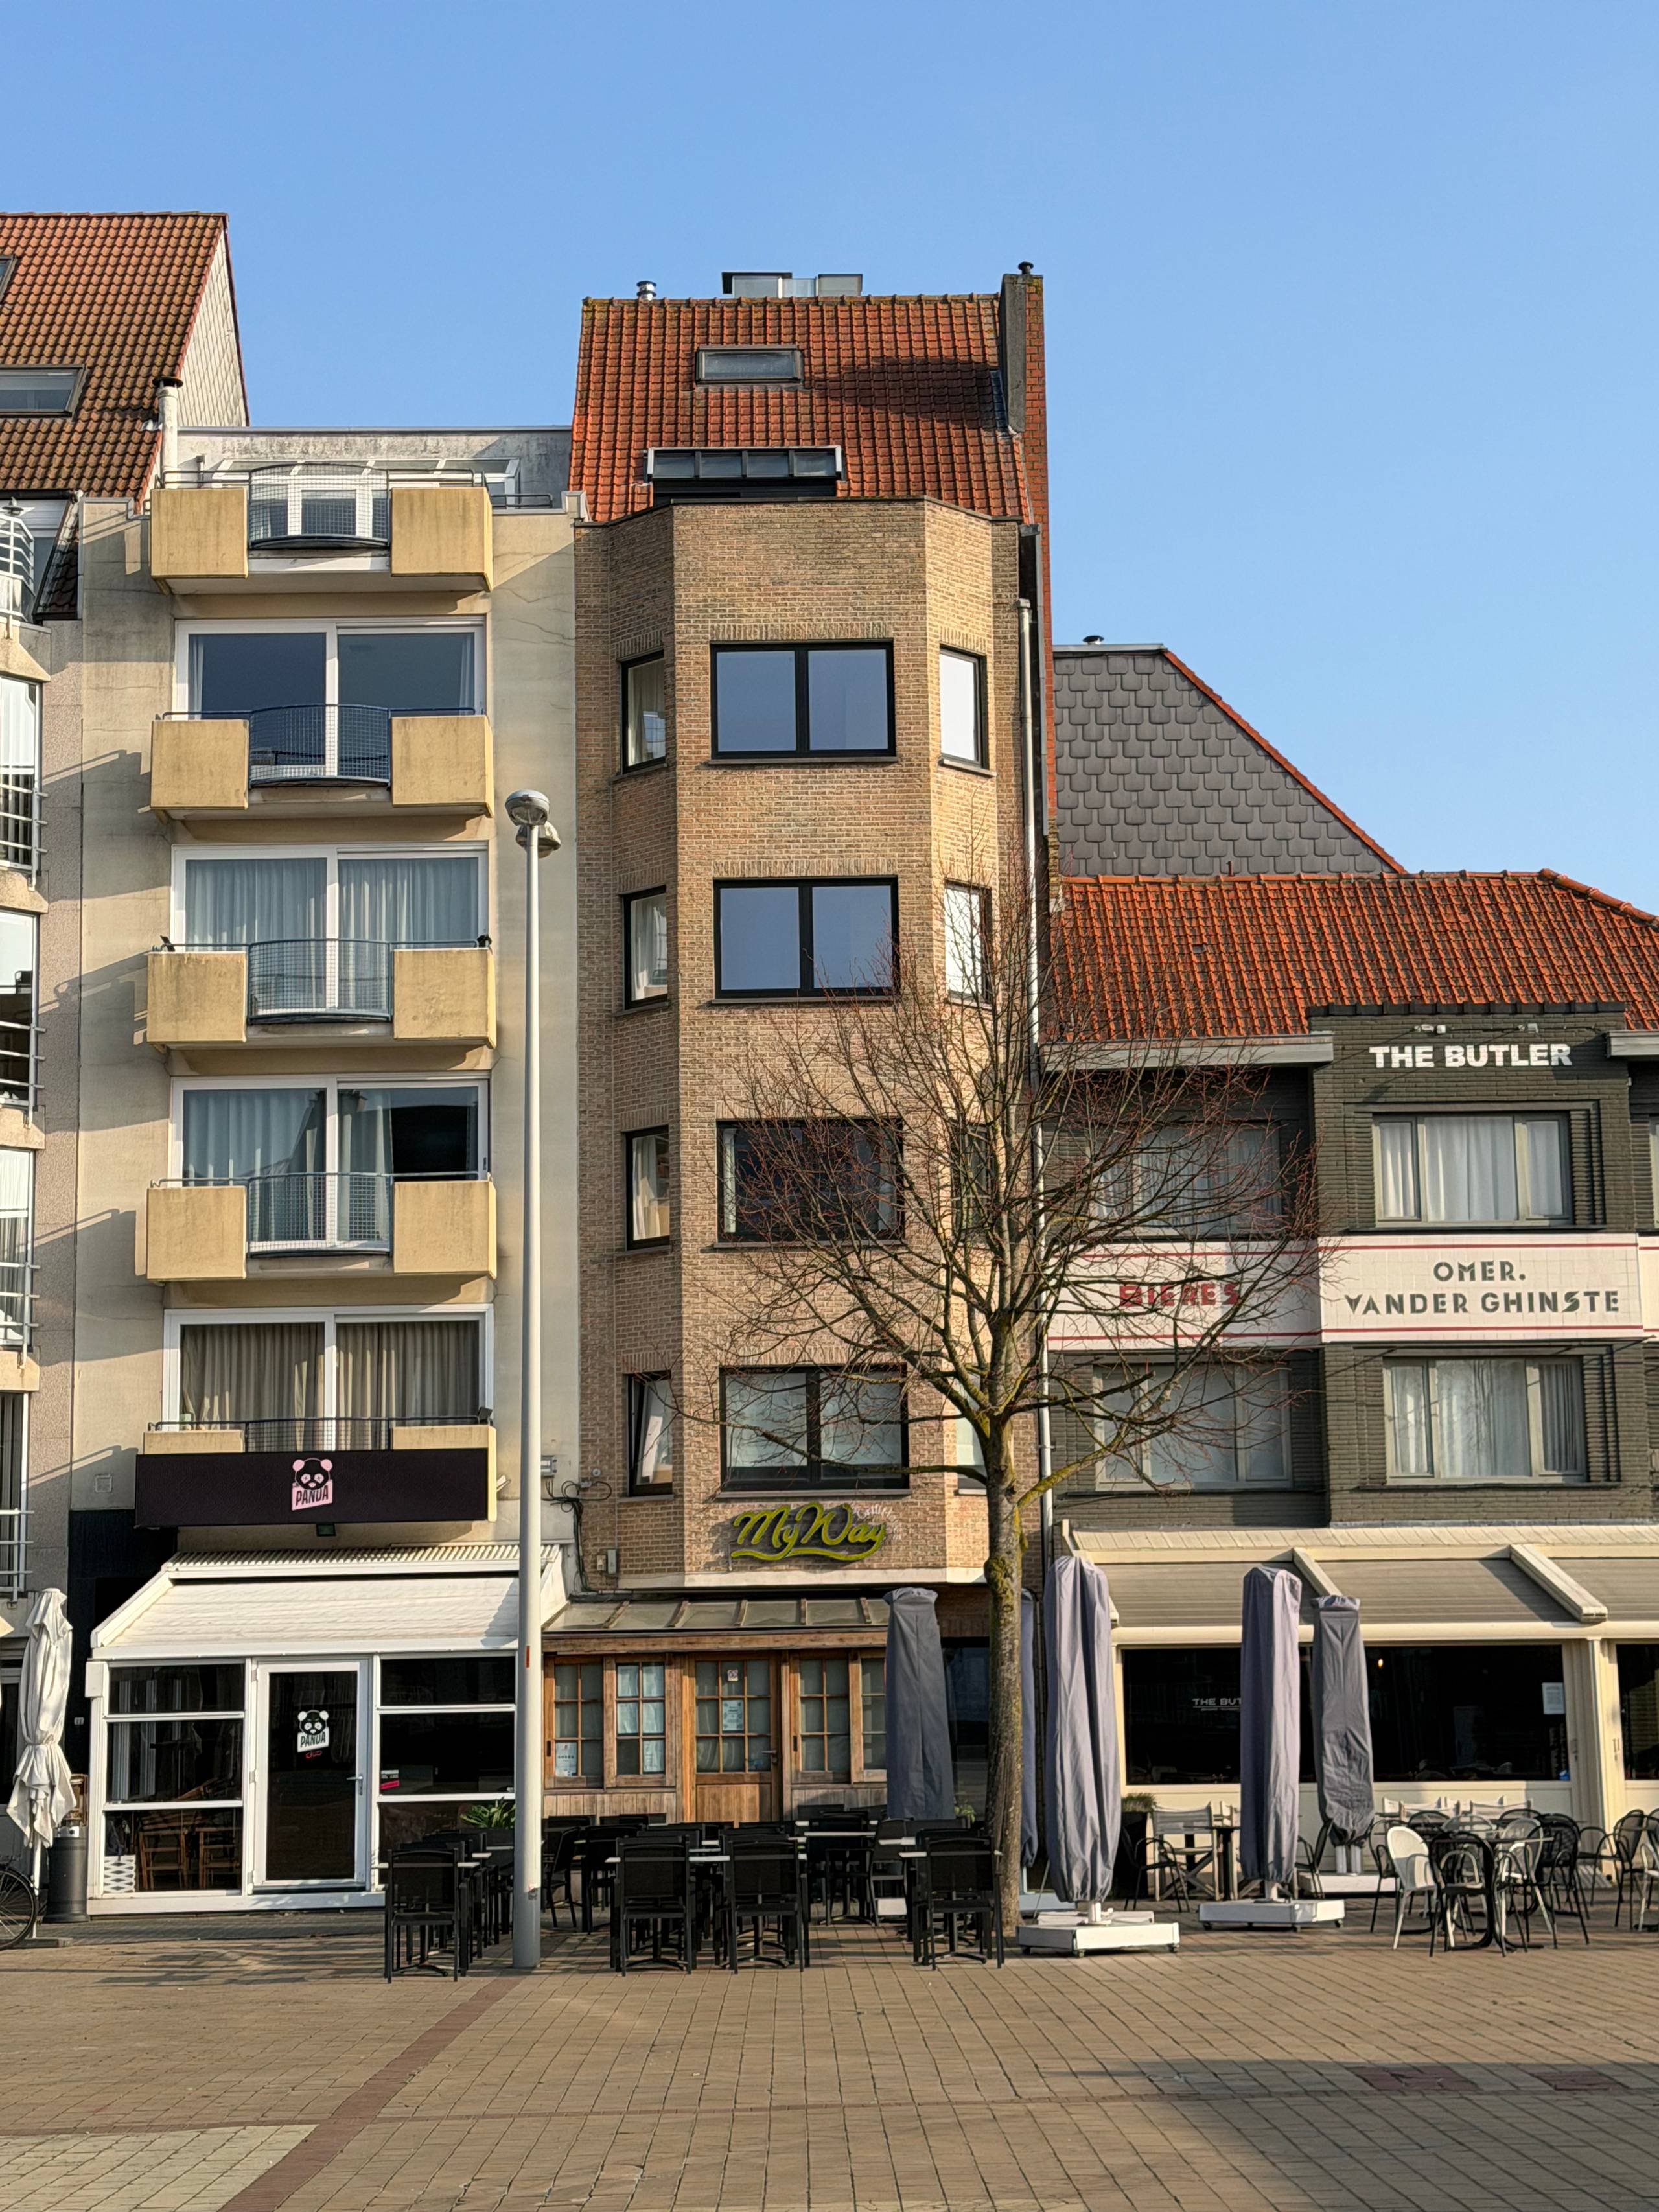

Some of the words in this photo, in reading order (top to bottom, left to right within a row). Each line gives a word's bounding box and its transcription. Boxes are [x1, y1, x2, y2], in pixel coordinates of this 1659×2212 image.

[1369, 1045, 1435, 1068] THE
[1444, 1043, 1573, 1067] BUTLER
[1433, 1260, 1526, 1282] OMER.
[1344, 1292, 1469, 1316] VANDER
[1481, 1290, 1620, 1314] GHINSTE
[295, 1485, 329, 1506] PANDA
[1192, 1697, 1217, 1706] THE
[1220, 1697, 1242, 1706] BUT
[300, 1731, 326, 1748] PANDA
